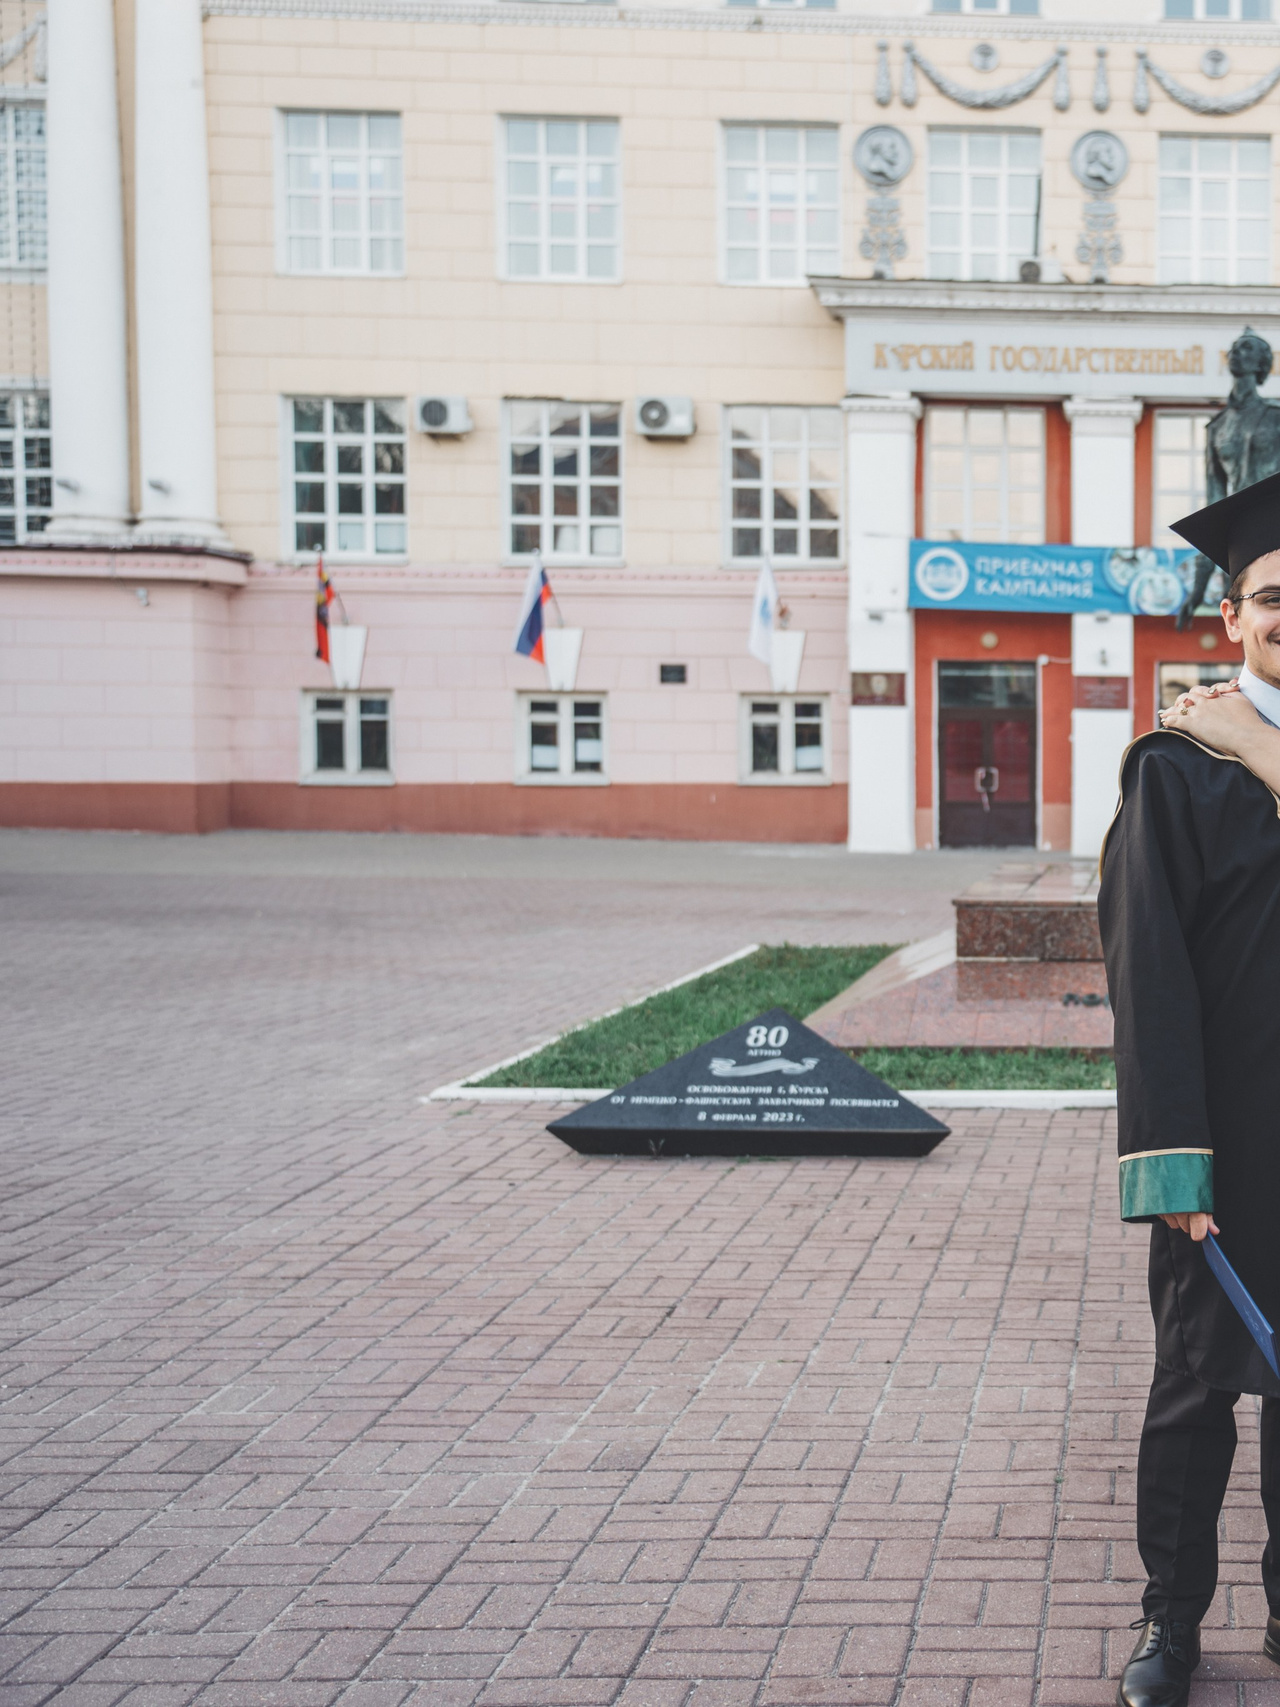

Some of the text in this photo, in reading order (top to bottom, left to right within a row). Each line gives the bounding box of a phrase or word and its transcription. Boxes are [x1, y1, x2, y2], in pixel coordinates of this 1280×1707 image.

[874, 341, 974, 371] КУРСКИЙ
[989, 344, 1204, 375] ГОСУДАРСТВЕННЫЙ
[975, 578, 1094, 599] КАМПАНИЯ
[746, 1025, 789, 1048] 80
[686, 1085, 772, 1094] ОСВОБОЖДЕНИЯ
[762, 1112, 794, 1122] 2023
